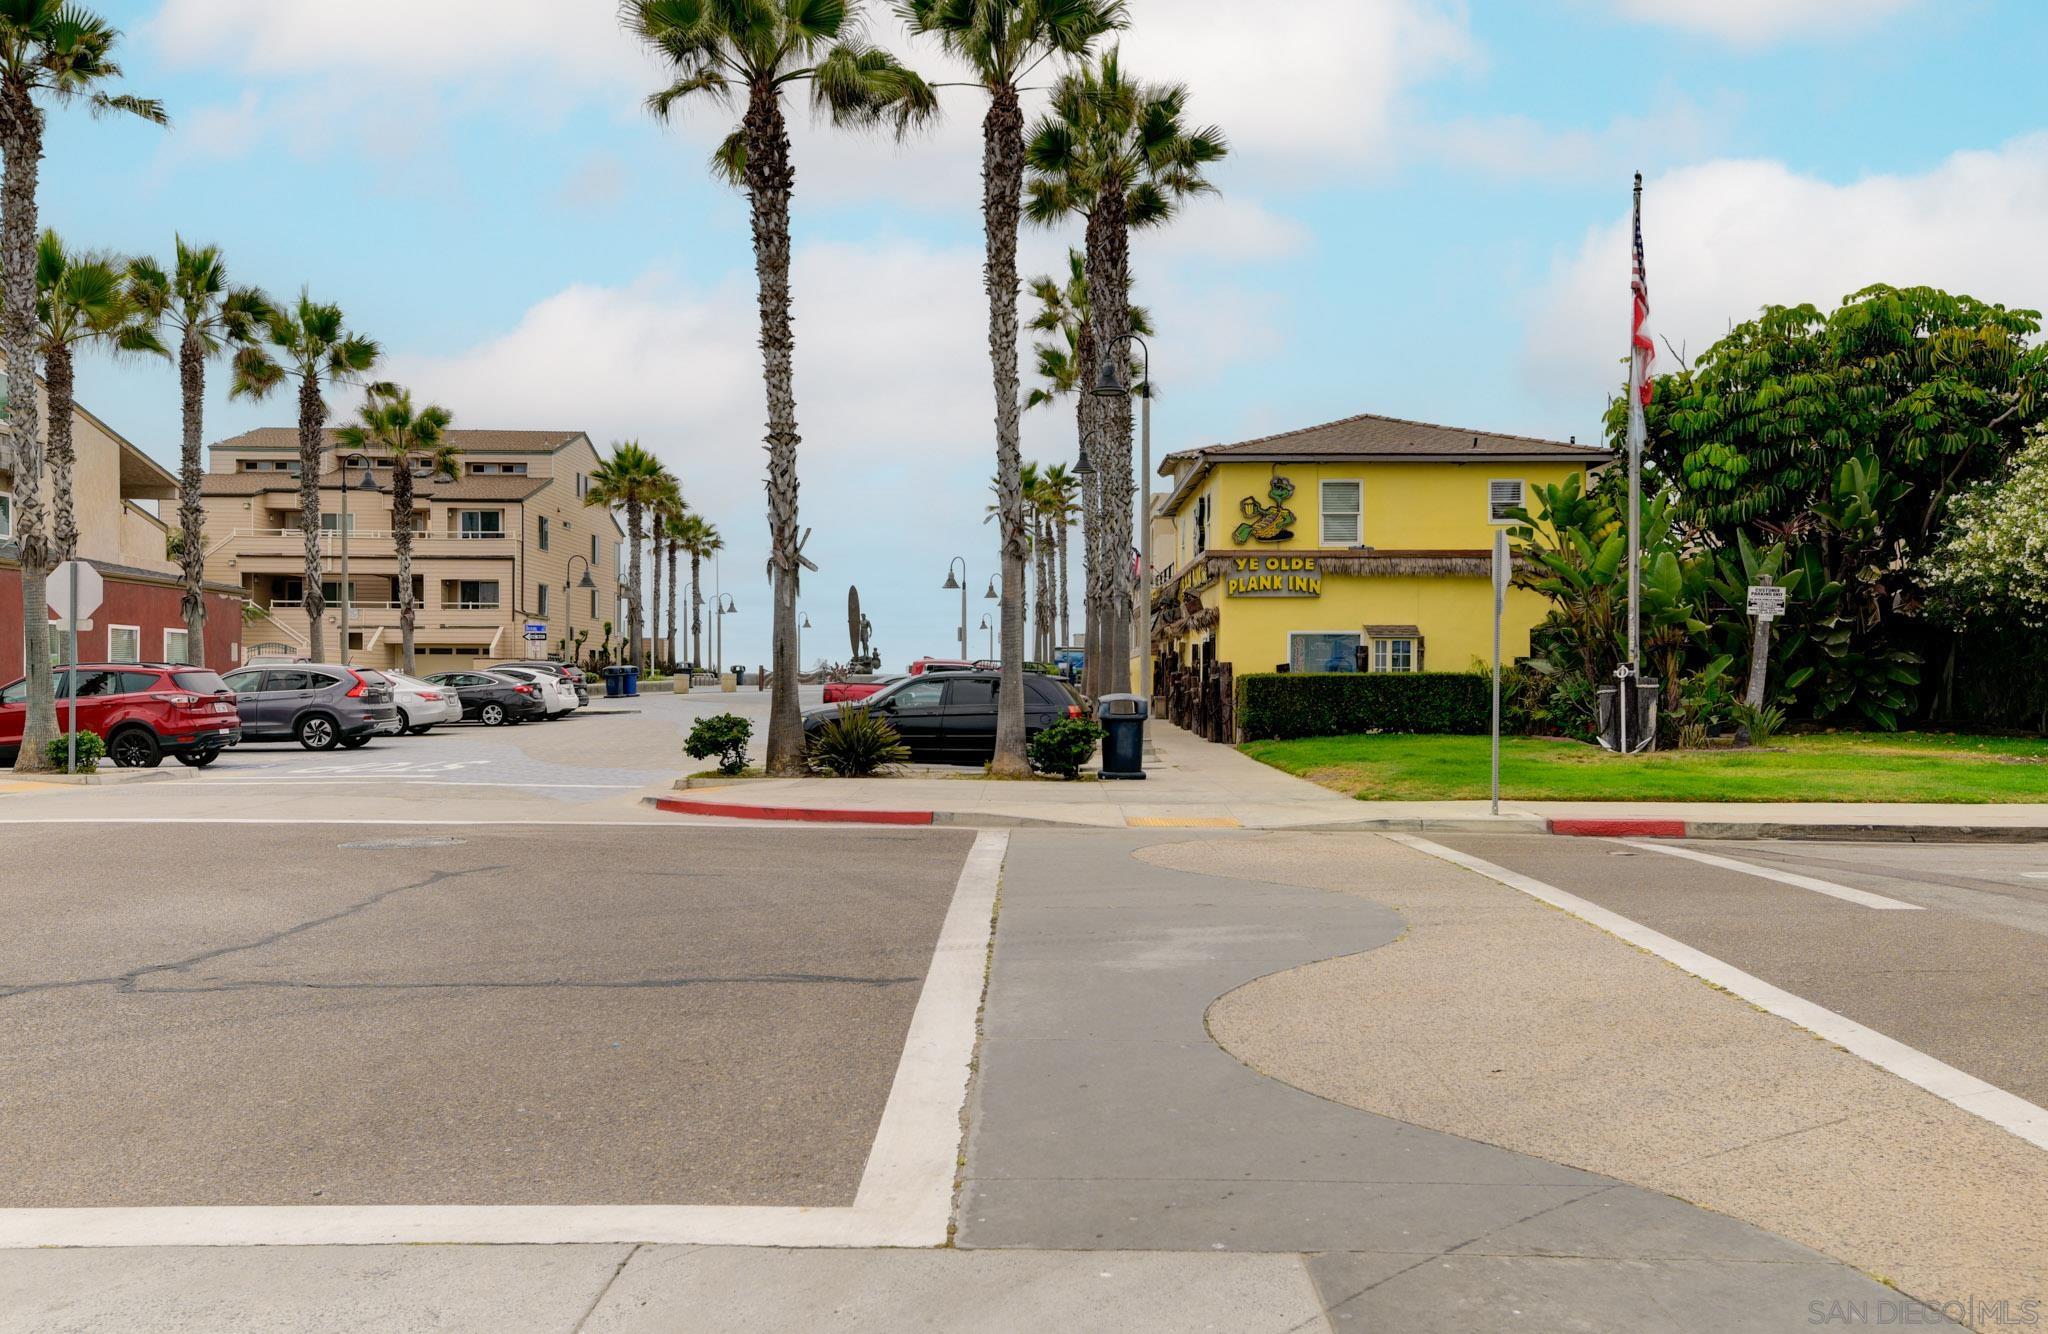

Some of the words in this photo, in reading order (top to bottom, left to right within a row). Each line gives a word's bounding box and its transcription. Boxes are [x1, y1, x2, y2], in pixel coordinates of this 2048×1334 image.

[1234, 557, 1259, 571] YE
[1265, 557, 1315, 571] OLDE
[1228, 575, 1283, 595] PLANK
[1288, 575, 1321, 595] INN
